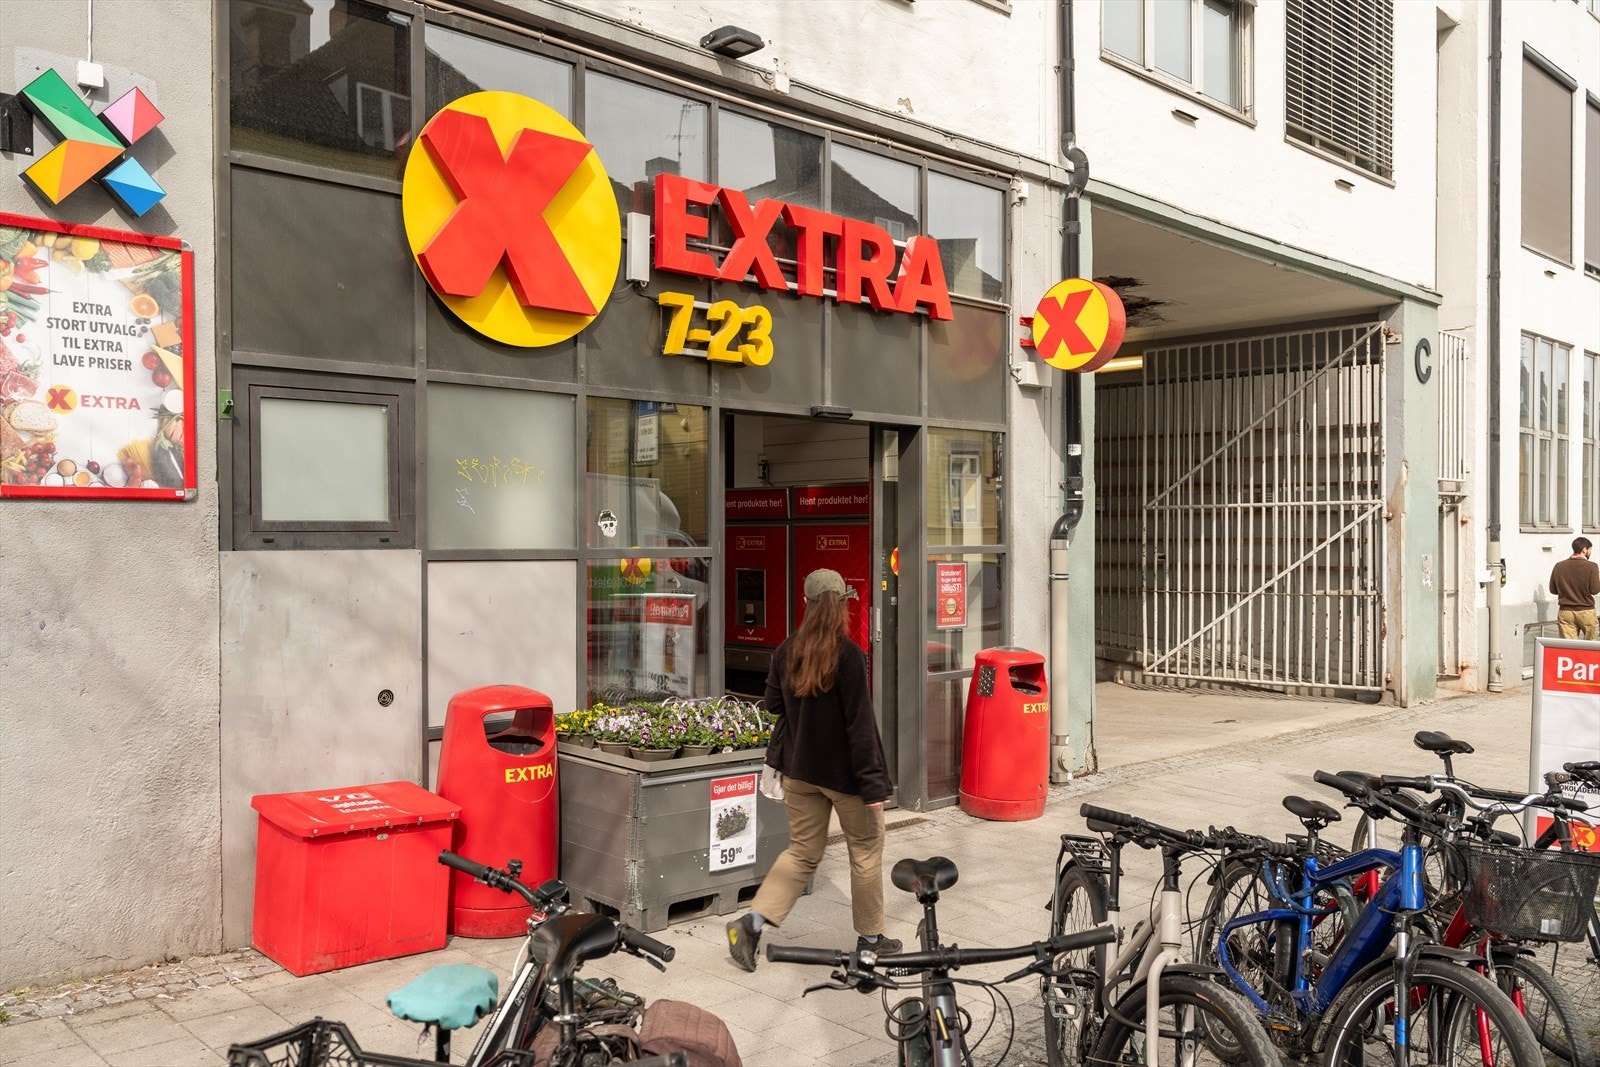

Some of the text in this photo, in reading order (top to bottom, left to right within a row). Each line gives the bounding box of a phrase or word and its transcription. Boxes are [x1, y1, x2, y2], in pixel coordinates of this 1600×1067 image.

[654, 173, 954, 322] EXTRA
[72, 301, 113, 317] EXTRA
[46, 317, 137, 337] STORT UTVALG
[658, 291, 775, 367] 7-23
[62, 336, 123, 353] TIL EXTRA
[53, 354, 132, 371] LAVE PRISER
[1415, 337, 1432, 385] C
[80, 394, 141, 410] EXTRA
[725, 498, 783, 509] ent produktet her!
[799, 494, 869, 507] Hent produktet her!
[1557, 656, 1600, 681] Par
[505, 763, 553, 783] EXTRA
[713, 780, 754, 795] Gjør det billig!
